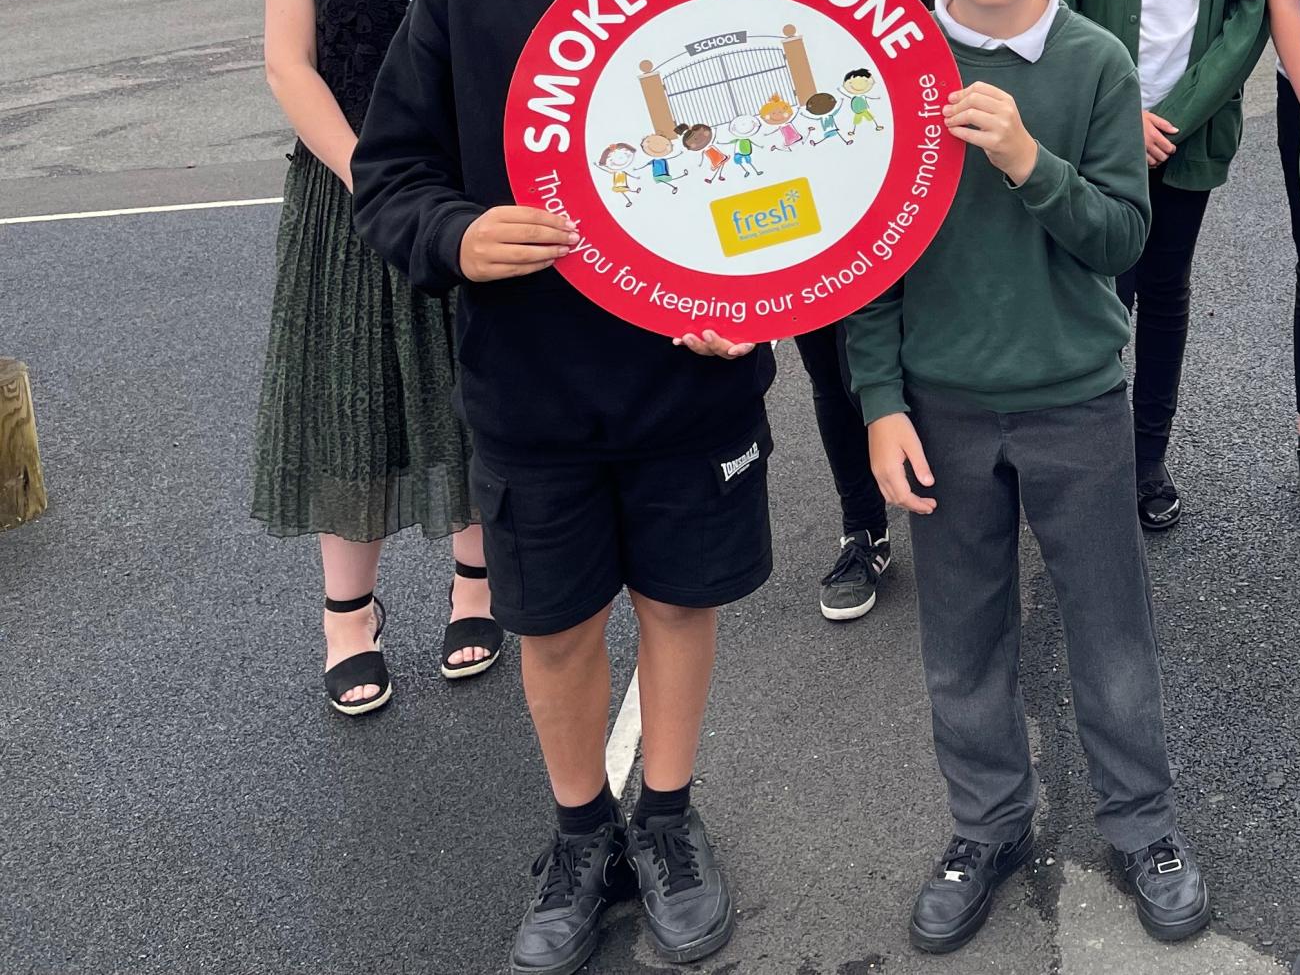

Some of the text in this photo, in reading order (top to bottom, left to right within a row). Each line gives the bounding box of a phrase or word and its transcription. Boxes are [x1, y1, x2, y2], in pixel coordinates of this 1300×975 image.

[693, 33, 740, 53] SCHOOL
[917, 73, 938, 123] free
[912, 124, 942, 199] smoke
[732, 199, 798, 234] fresh
[872, 201, 920, 259] gates
[569, 237, 613, 274] you
[613, 266, 647, 295] for
[801, 253, 873, 304] school
[649, 283, 747, 322] keeping
[755, 291, 794, 316] our
